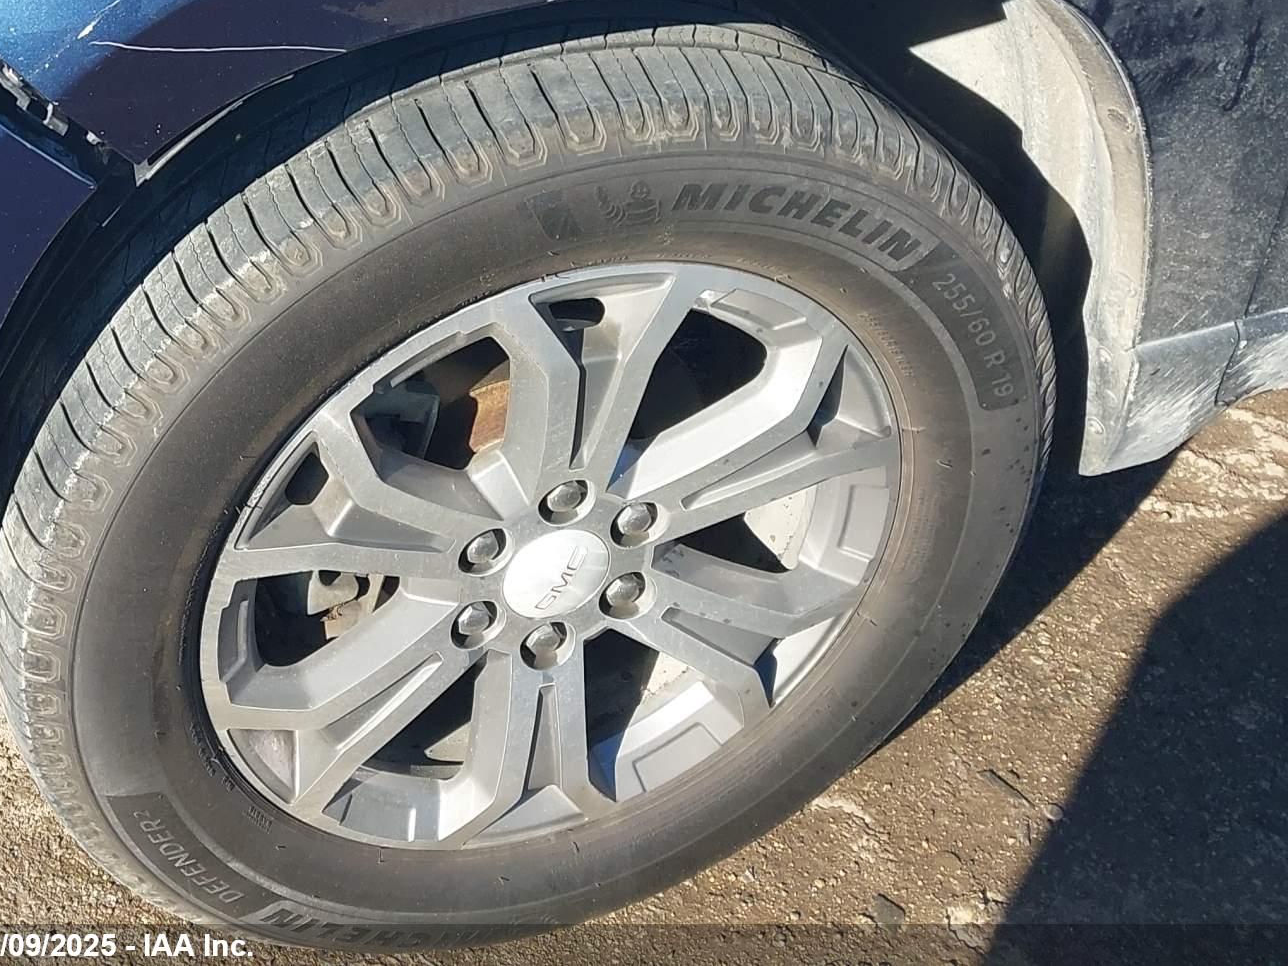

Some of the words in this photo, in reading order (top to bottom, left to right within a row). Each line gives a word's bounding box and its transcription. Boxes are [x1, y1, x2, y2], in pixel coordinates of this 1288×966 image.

[670, 183, 922, 262] MICHELIN
[932, 273, 997, 347] 255/60
[534, 546, 589, 610] GMC
